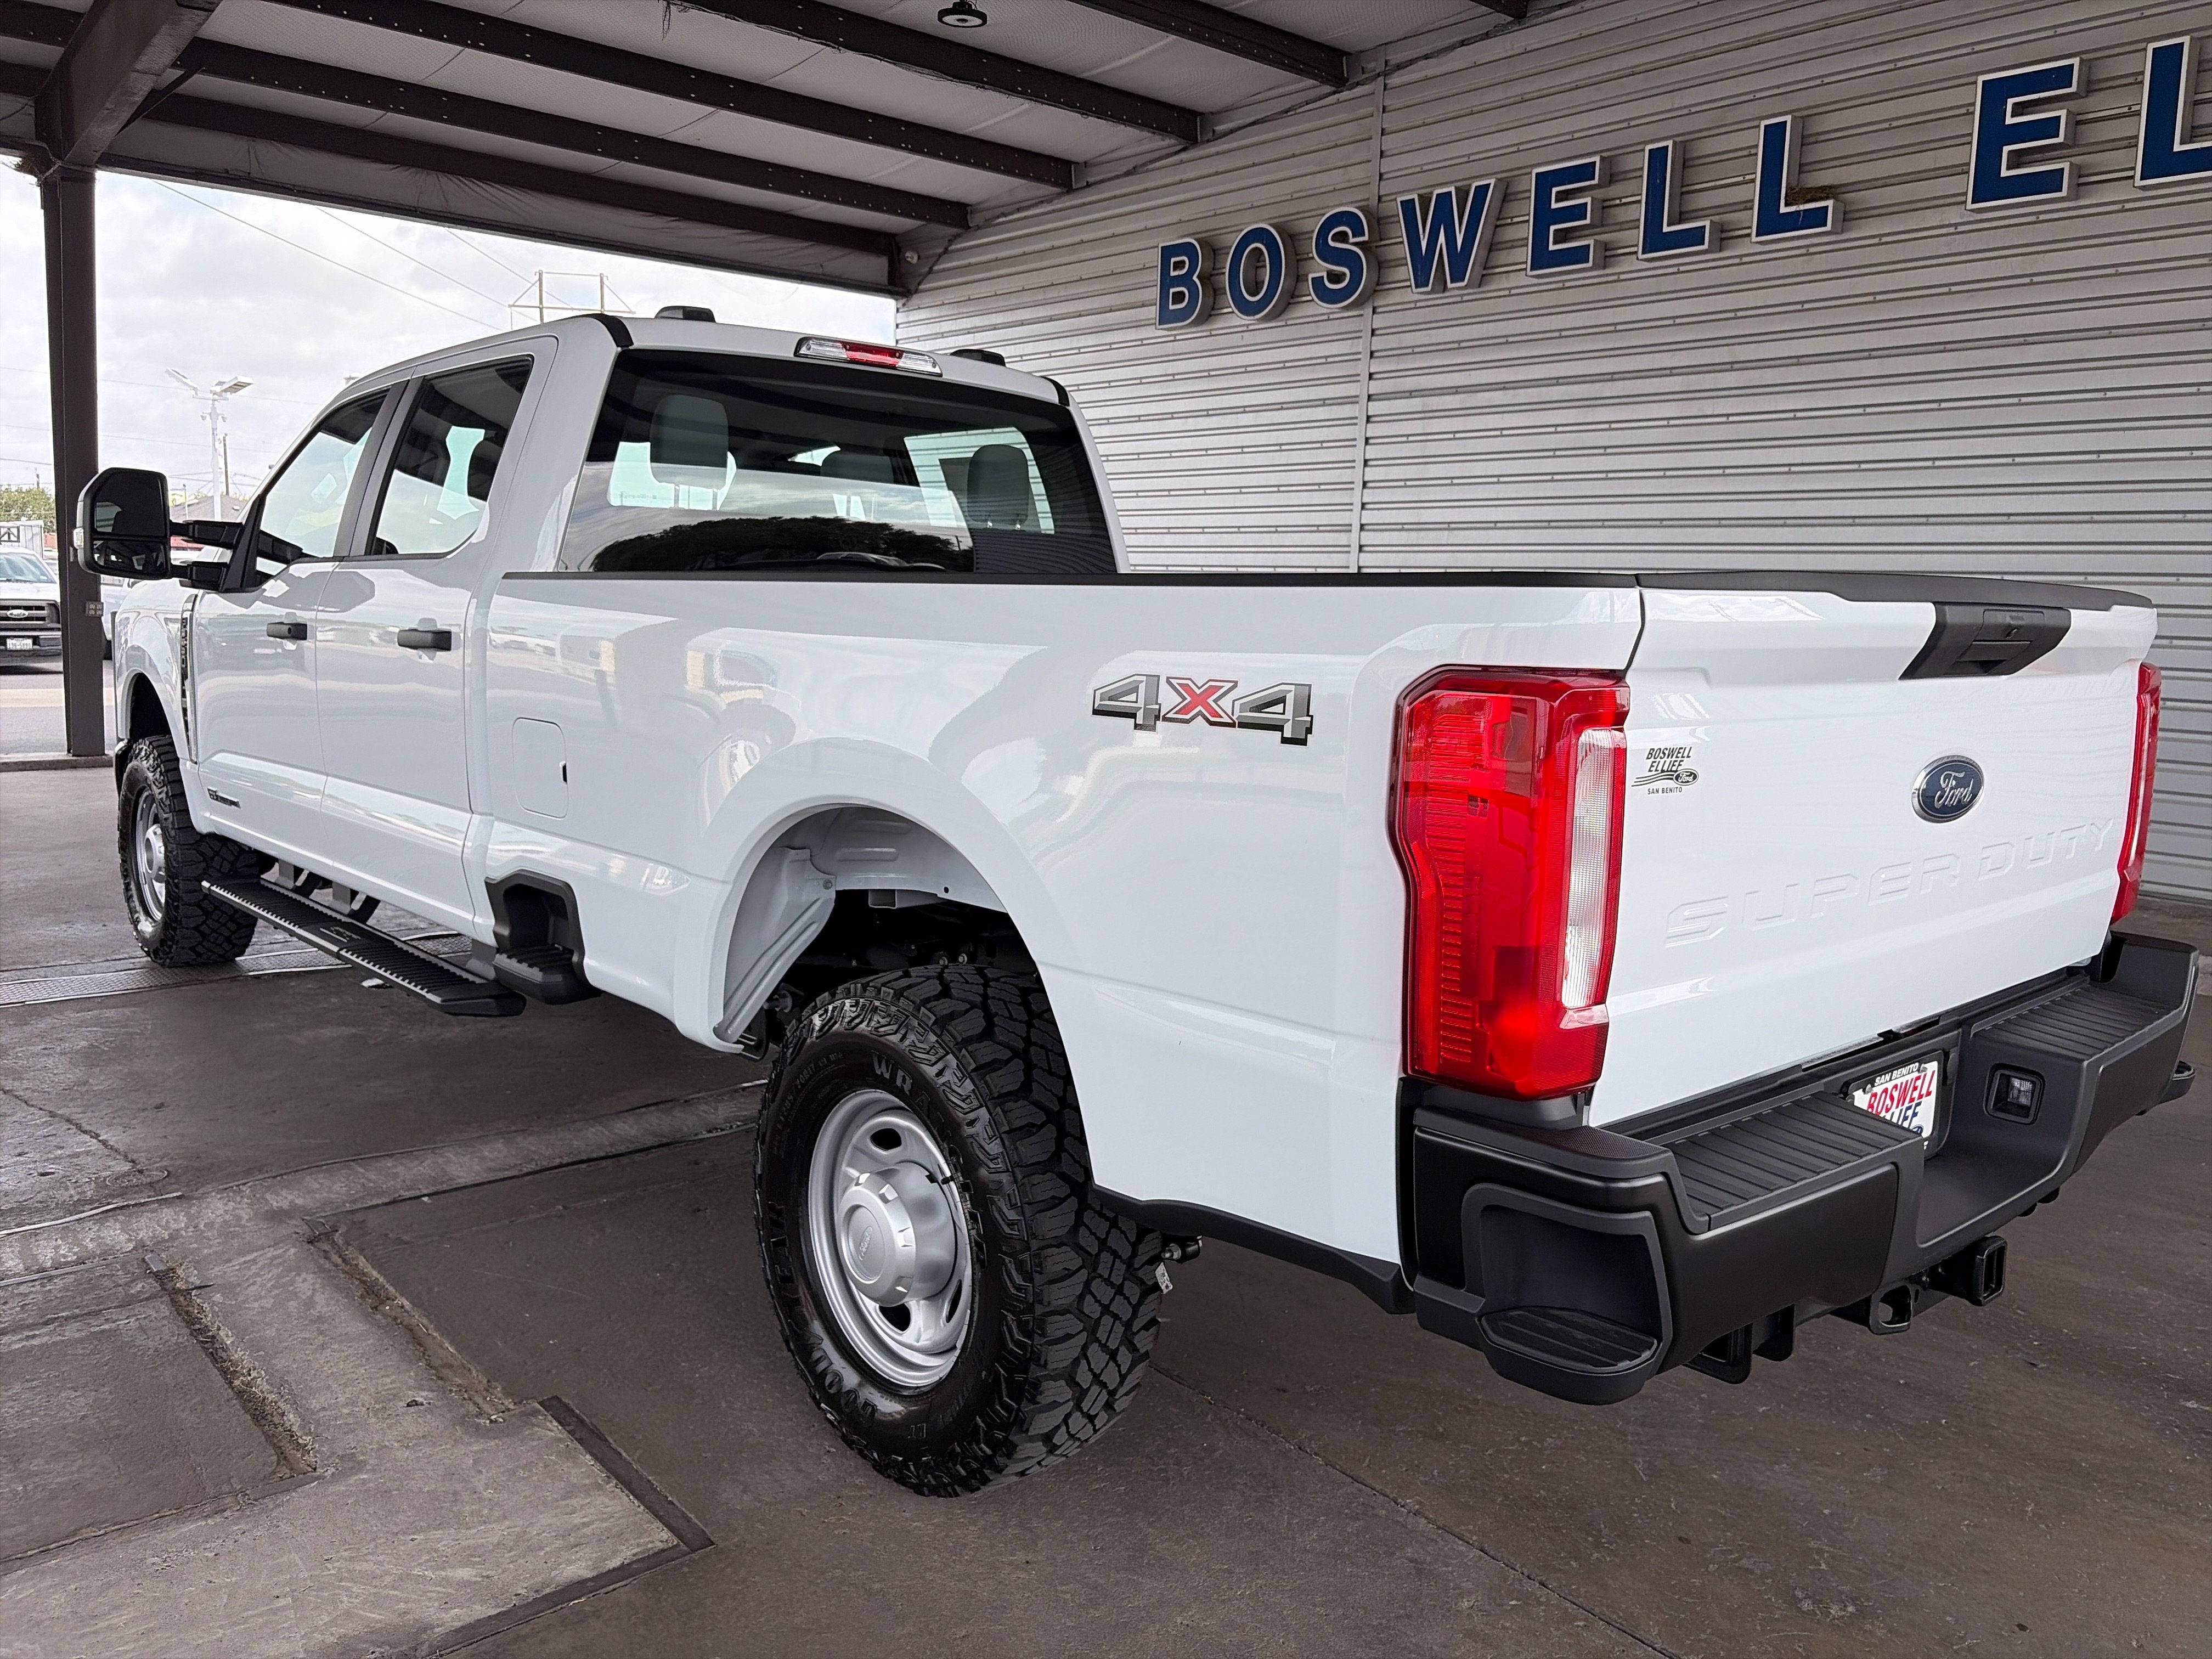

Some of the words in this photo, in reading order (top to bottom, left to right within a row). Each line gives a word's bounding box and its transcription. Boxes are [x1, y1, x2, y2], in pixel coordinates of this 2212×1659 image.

[1155, 115, 1844, 331] BOSWELL
[1965, 35, 2212, 211] EL
[1646, 747, 1692, 760] BOSWELL
[1678, 772, 1694, 782] Ford
[1934, 771, 1974, 809] Ford
[1664, 854, 1961, 947] SUPER
[1978, 817, 2114, 878] DUTY
[1866, 1070, 1936, 1116] BOSWELL
[1874, 1072, 1892, 1086] SAN
[1892, 1062, 1919, 1080] BENITO
